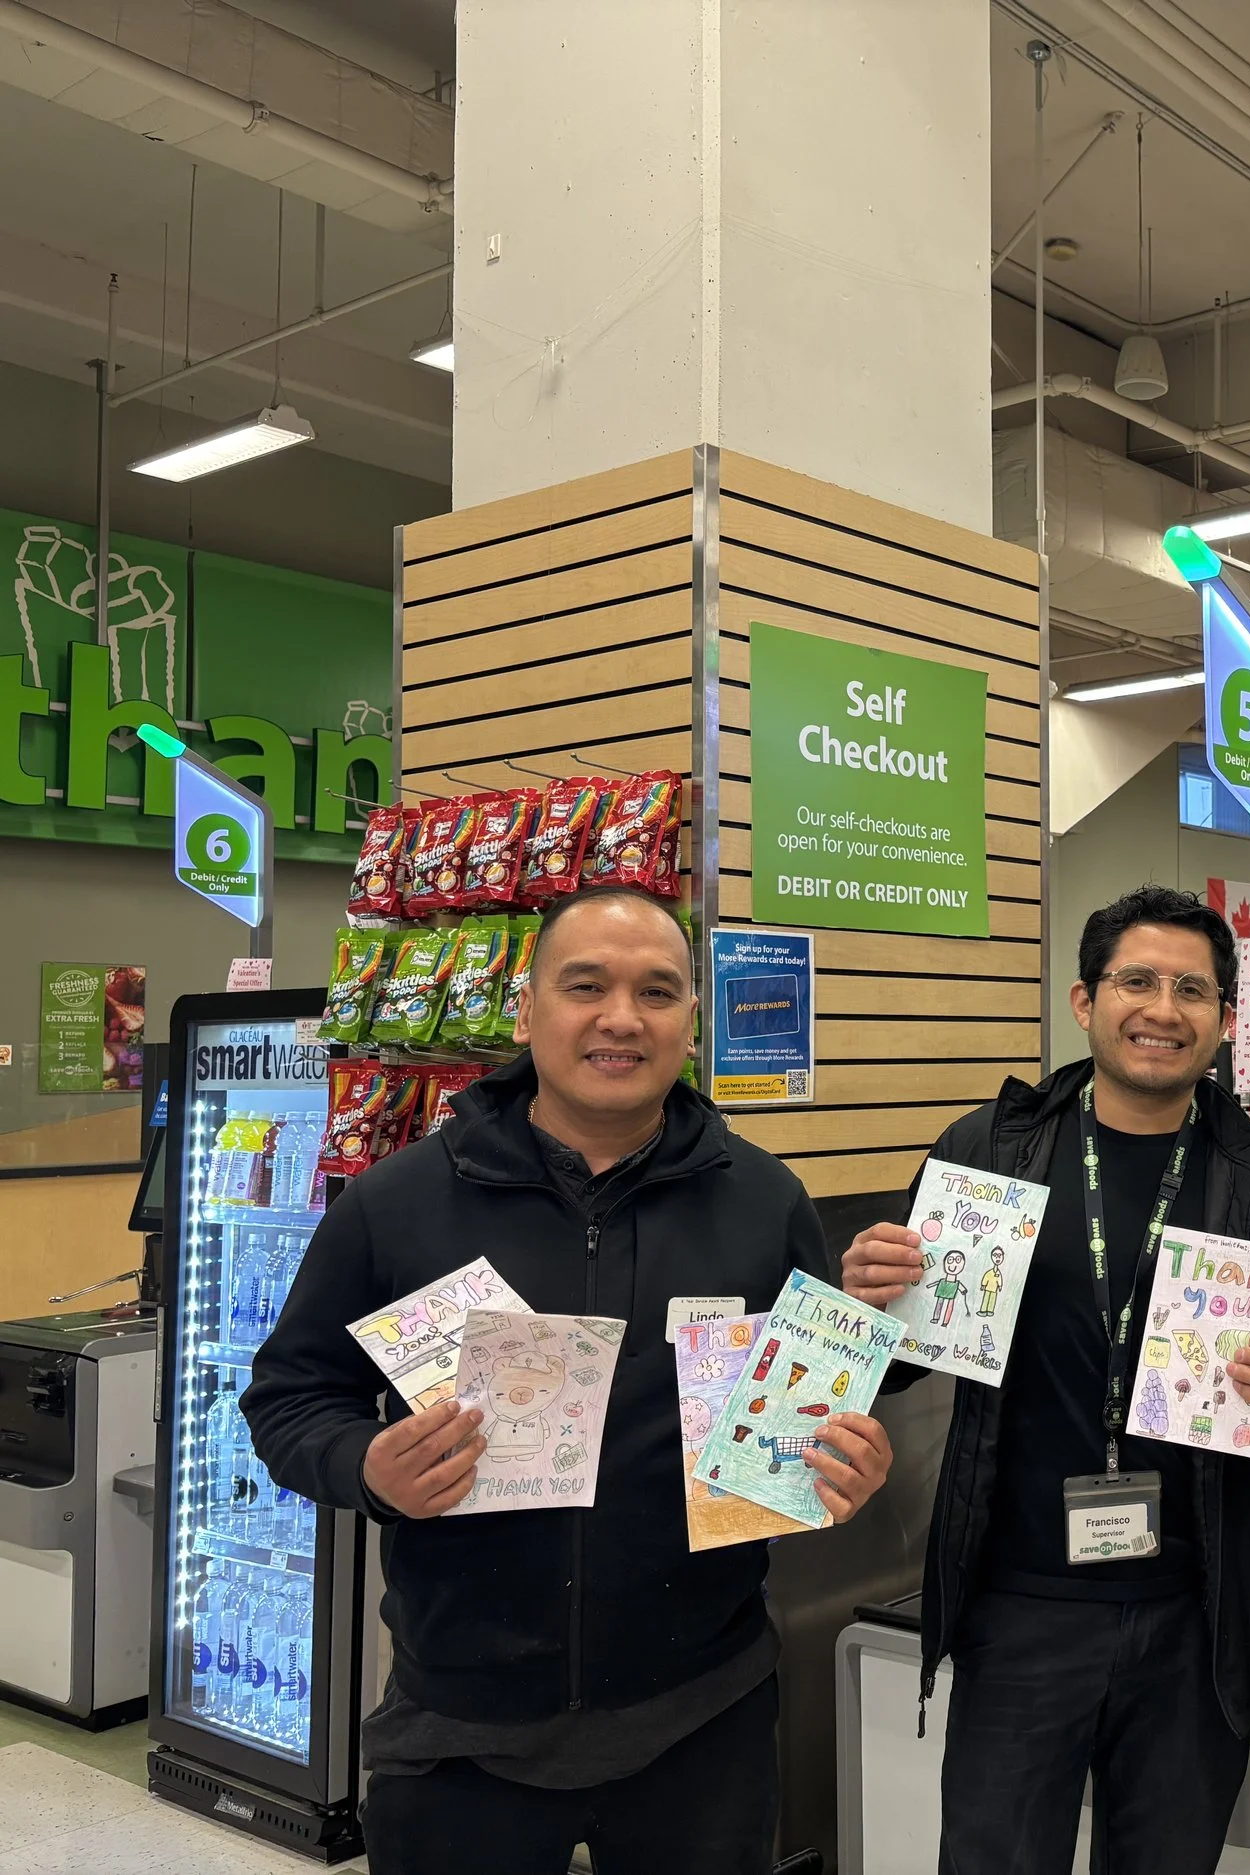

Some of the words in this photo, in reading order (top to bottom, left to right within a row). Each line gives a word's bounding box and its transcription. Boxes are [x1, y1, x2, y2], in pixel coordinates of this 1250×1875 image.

[846, 680, 906, 725] Self
[0, 641, 392, 834] than
[799, 725, 948, 782] Checkout
[797, 806, 826, 827] Our
[830, 811, 926, 839] self-checkouts
[931, 824, 950, 841] are
[206, 829, 232, 863] 6
[778, 832, 818, 852] open
[822, 833, 842, 852] for
[847, 842, 878, 859] your
[882, 846, 967, 866] convenience.
[209, 883, 230, 893] Only
[778, 876, 831, 898] DEBIT
[836, 881, 860, 900] OR
[865, 883, 922, 904] CREDIT
[927, 888, 968, 908] ONLY
[719, 953, 737, 961] More
[738, 954, 767, 963] Rewards
[769, 956, 783, 964] card
[785, 958, 806, 966] today!
[736, 943, 751, 954] Sign
[753, 946, 761, 954] up
[774, 947, 789, 955] your
[49, 977, 99, 991] FRESHNESS
[230, 1027, 263, 1042] GLACÉAU
[941, 1173, 1027, 1208] Thank
[952, 1200, 998, 1234] You
[355, 1270, 503, 1344] THANK
[794, 1288, 866, 1338] Thank
[680, 1321, 751, 1353] Tha
[476, 1478, 542, 1498] THANK
[550, 1478, 584, 1496] YOU
[1086, 1517, 1130, 1528] Francisco
[1092, 1530, 1125, 1539] Supervisor
